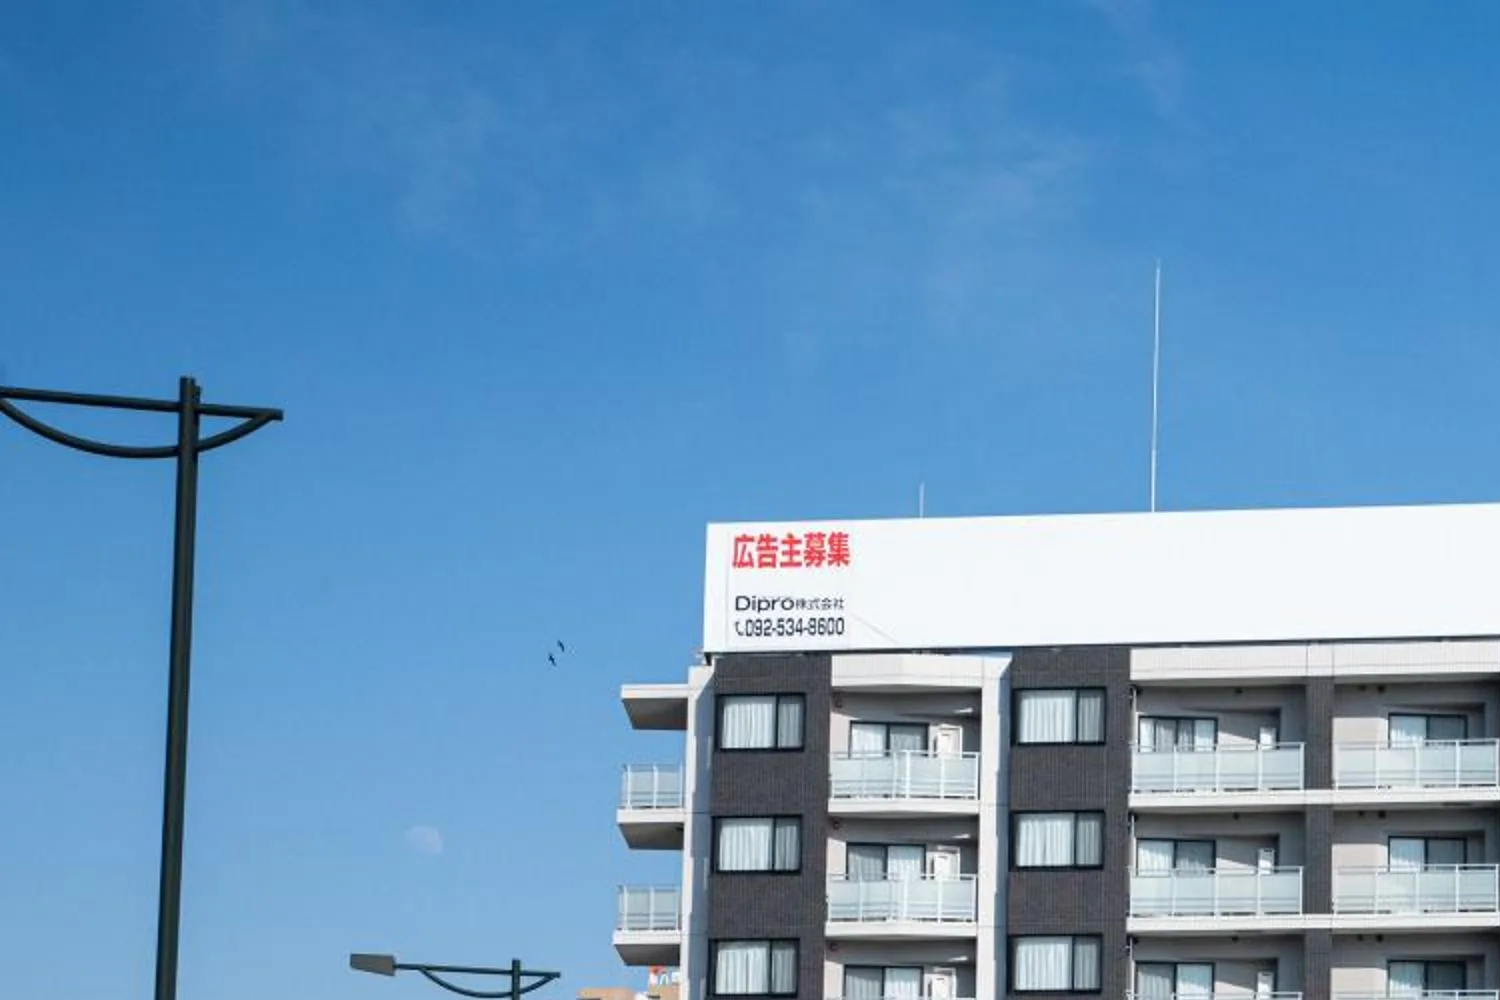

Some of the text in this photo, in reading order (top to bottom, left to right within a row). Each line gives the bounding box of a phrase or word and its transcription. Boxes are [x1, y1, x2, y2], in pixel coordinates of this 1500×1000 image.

[732, 531, 850, 568] 広告主募集
